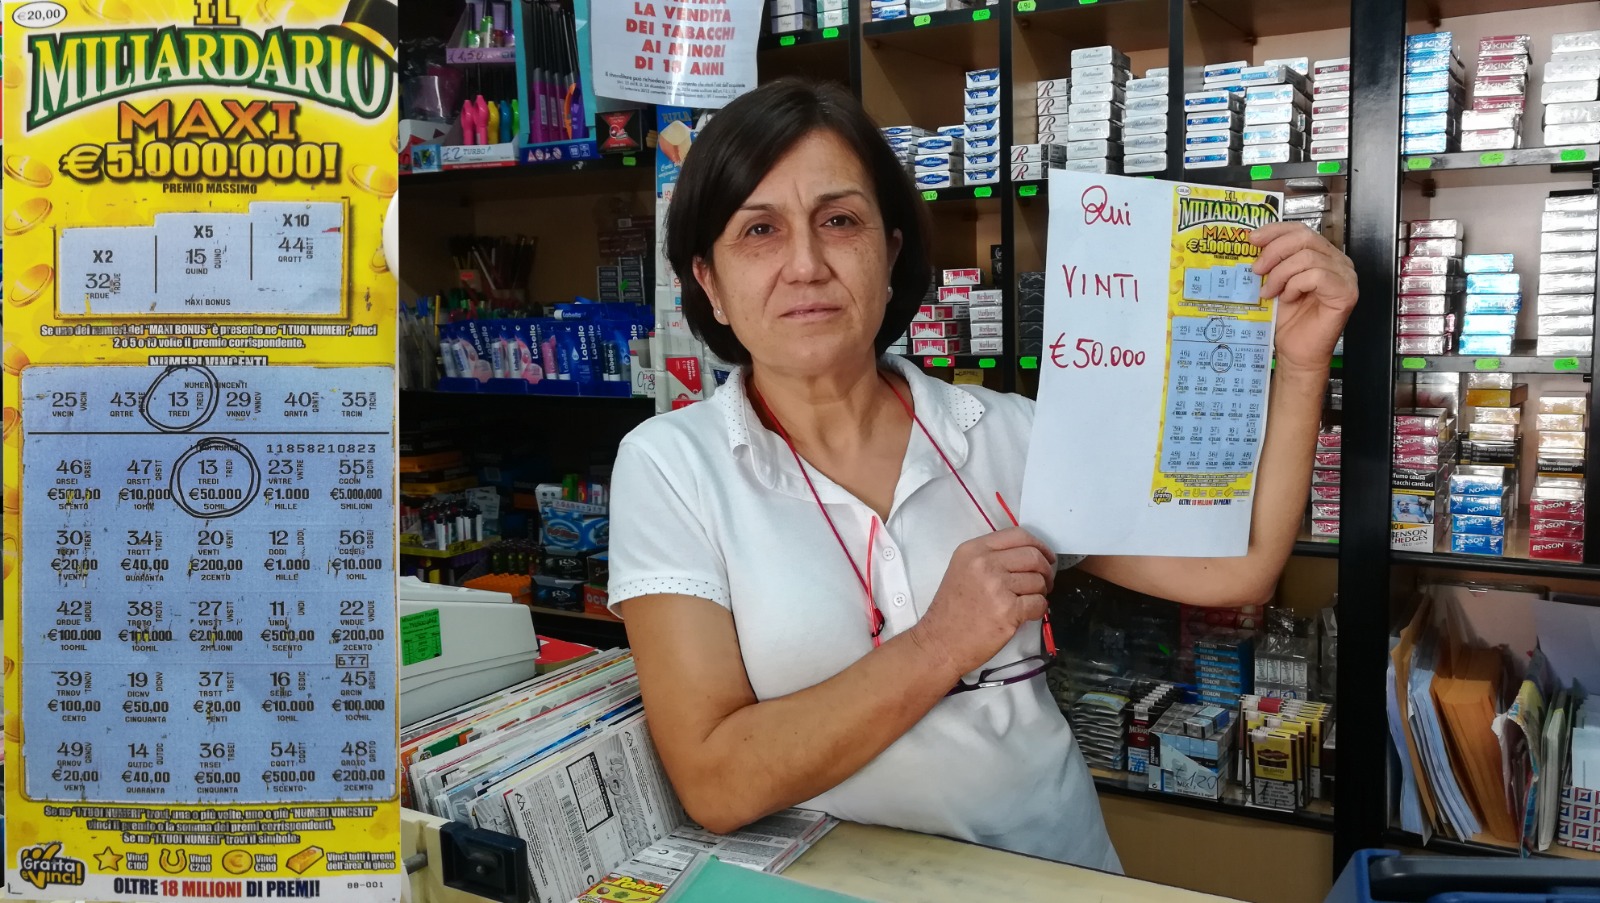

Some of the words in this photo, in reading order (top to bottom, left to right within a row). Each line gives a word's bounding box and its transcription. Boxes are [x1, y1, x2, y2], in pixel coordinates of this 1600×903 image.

[17, 8, 61, 22] €20,00
[194, 0, 240, 26] IL
[635, 2, 656, 17] LA
[664, 6, 731, 22] VENDITA
[626, 19, 654, 35] DEI
[662, 24, 735, 40] TABACCHI
[642, 39, 661, 53] AI
[635, 56, 653, 70] DI
[663, 60, 682, 73] 18
[690, 62, 724, 75] ANNI
[28, 26, 389, 130] MILIARDARIO
[119, 100, 297, 141] MAXI
[59, 142, 341, 181] €5.000.000!
[163, 184, 203, 194] PREMIO
[206, 184, 257, 194] MASSIMO
[1225, 190, 1238, 202] IL
[1081, 185, 1131, 226] Qui
[283, 214, 309, 227] X10
[194, 226, 213, 238] X5
[278, 238, 305, 253] 44
[93, 250, 113, 263] X2
[186, 249, 207, 265] 15
[86, 274, 110, 289] 32
[1062, 264, 1138, 302] VINTI
[41, 325, 54, 336] Se
[75, 325, 90, 336] dei
[128, 324, 144, 335] del
[220, 325, 263, 336] presente
[265, 326, 277, 335] ne
[288, 324, 310, 335] TUOI
[353, 324, 377, 335] vinci
[114, 338, 120, 348] 2
[130, 337, 137, 348] 5
[159, 338, 182, 348] volte
[184, 338, 191, 348] il
[192, 338, 227, 349] premio
[228, 338, 305, 349] corrispondente.
[469, 322, 483, 355] Labello
[529, 325, 538, 359] Labello
[578, 326, 588, 360] Labello
[1049, 332, 1146, 368] €50.000
[52, 392, 77, 407] 25
[110, 392, 136, 407] 43
[168, 392, 188, 407] 13
[226, 392, 251, 407] 29
[284, 392, 311, 407] 40
[342, 392, 367, 407] 35
[267, 444, 376, 453] 11858210823
[56, 460, 83, 474] 46
[127, 460, 152, 474] 47
[198, 460, 218, 474] 13
[268, 460, 293, 474] 23
[339, 460, 365, 474] 55
[120, 488, 171, 500] €10.000
[189, 488, 242, 500] €50.000
[264, 488, 309, 500] €1.000
[330, 488, 382, 500] €5.000.000
[1534, 502, 1565, 510] BENSON
[1534, 522, 1565, 530] BENSON
[56, 530, 83, 545] 30
[127, 530, 153, 545] 34
[198, 530, 224, 545] 20
[269, 530, 288, 545] 12
[339, 530, 365, 545] 56
[1533, 542, 1564, 551] BENSON
[121, 559, 169, 571] €40,00
[190, 559, 243, 571] €200,00
[264, 559, 310, 571] €1.000
[332, 559, 382, 571] €10.000
[56, 601, 82, 616] 42
[127, 601, 153, 616] 38
[198, 601, 222, 616] 27
[269, 601, 285, 616] 11
[340, 601, 364, 616] 22
[48, 629, 101, 642] €100.000
[260, 629, 315, 642] €500,00
[332, 629, 384, 642] €200,00
[338, 656, 366, 666] 677
[57, 671, 82, 686] 39
[128, 672, 148, 687] 19
[199, 672, 223, 687] 37
[270, 672, 290, 687] 16
[341, 671, 367, 686] 45
[48, 700, 101, 712] €100,00
[123, 701, 169, 713] €50,00
[262, 700, 314, 712] €10.000
[332, 700, 385, 712] €100.000
[57, 742, 83, 757] 49
[128, 743, 149, 758] 14
[200, 743, 225, 758] 36
[271, 742, 297, 757] 54
[341, 741, 367, 756] 48
[52, 769, 98, 782] €20,00
[122, 770, 170, 783] €40,00
[194, 772, 240, 784] €50,00
[262, 770, 315, 783] €500,00
[332, 769, 385, 782] €200,00
[23, 858, 75, 872] Gratta
[126, 853, 148, 862] Vinci
[190, 855, 211, 863] Vinci
[256, 854, 276, 863] Vinci
[114, 878, 158, 895] OLTRE
[160, 880, 178, 896] 18
[182, 881, 242, 898] MILIONI
[246, 881, 263, 897] DI
[267, 880, 320, 898] PREMI!
